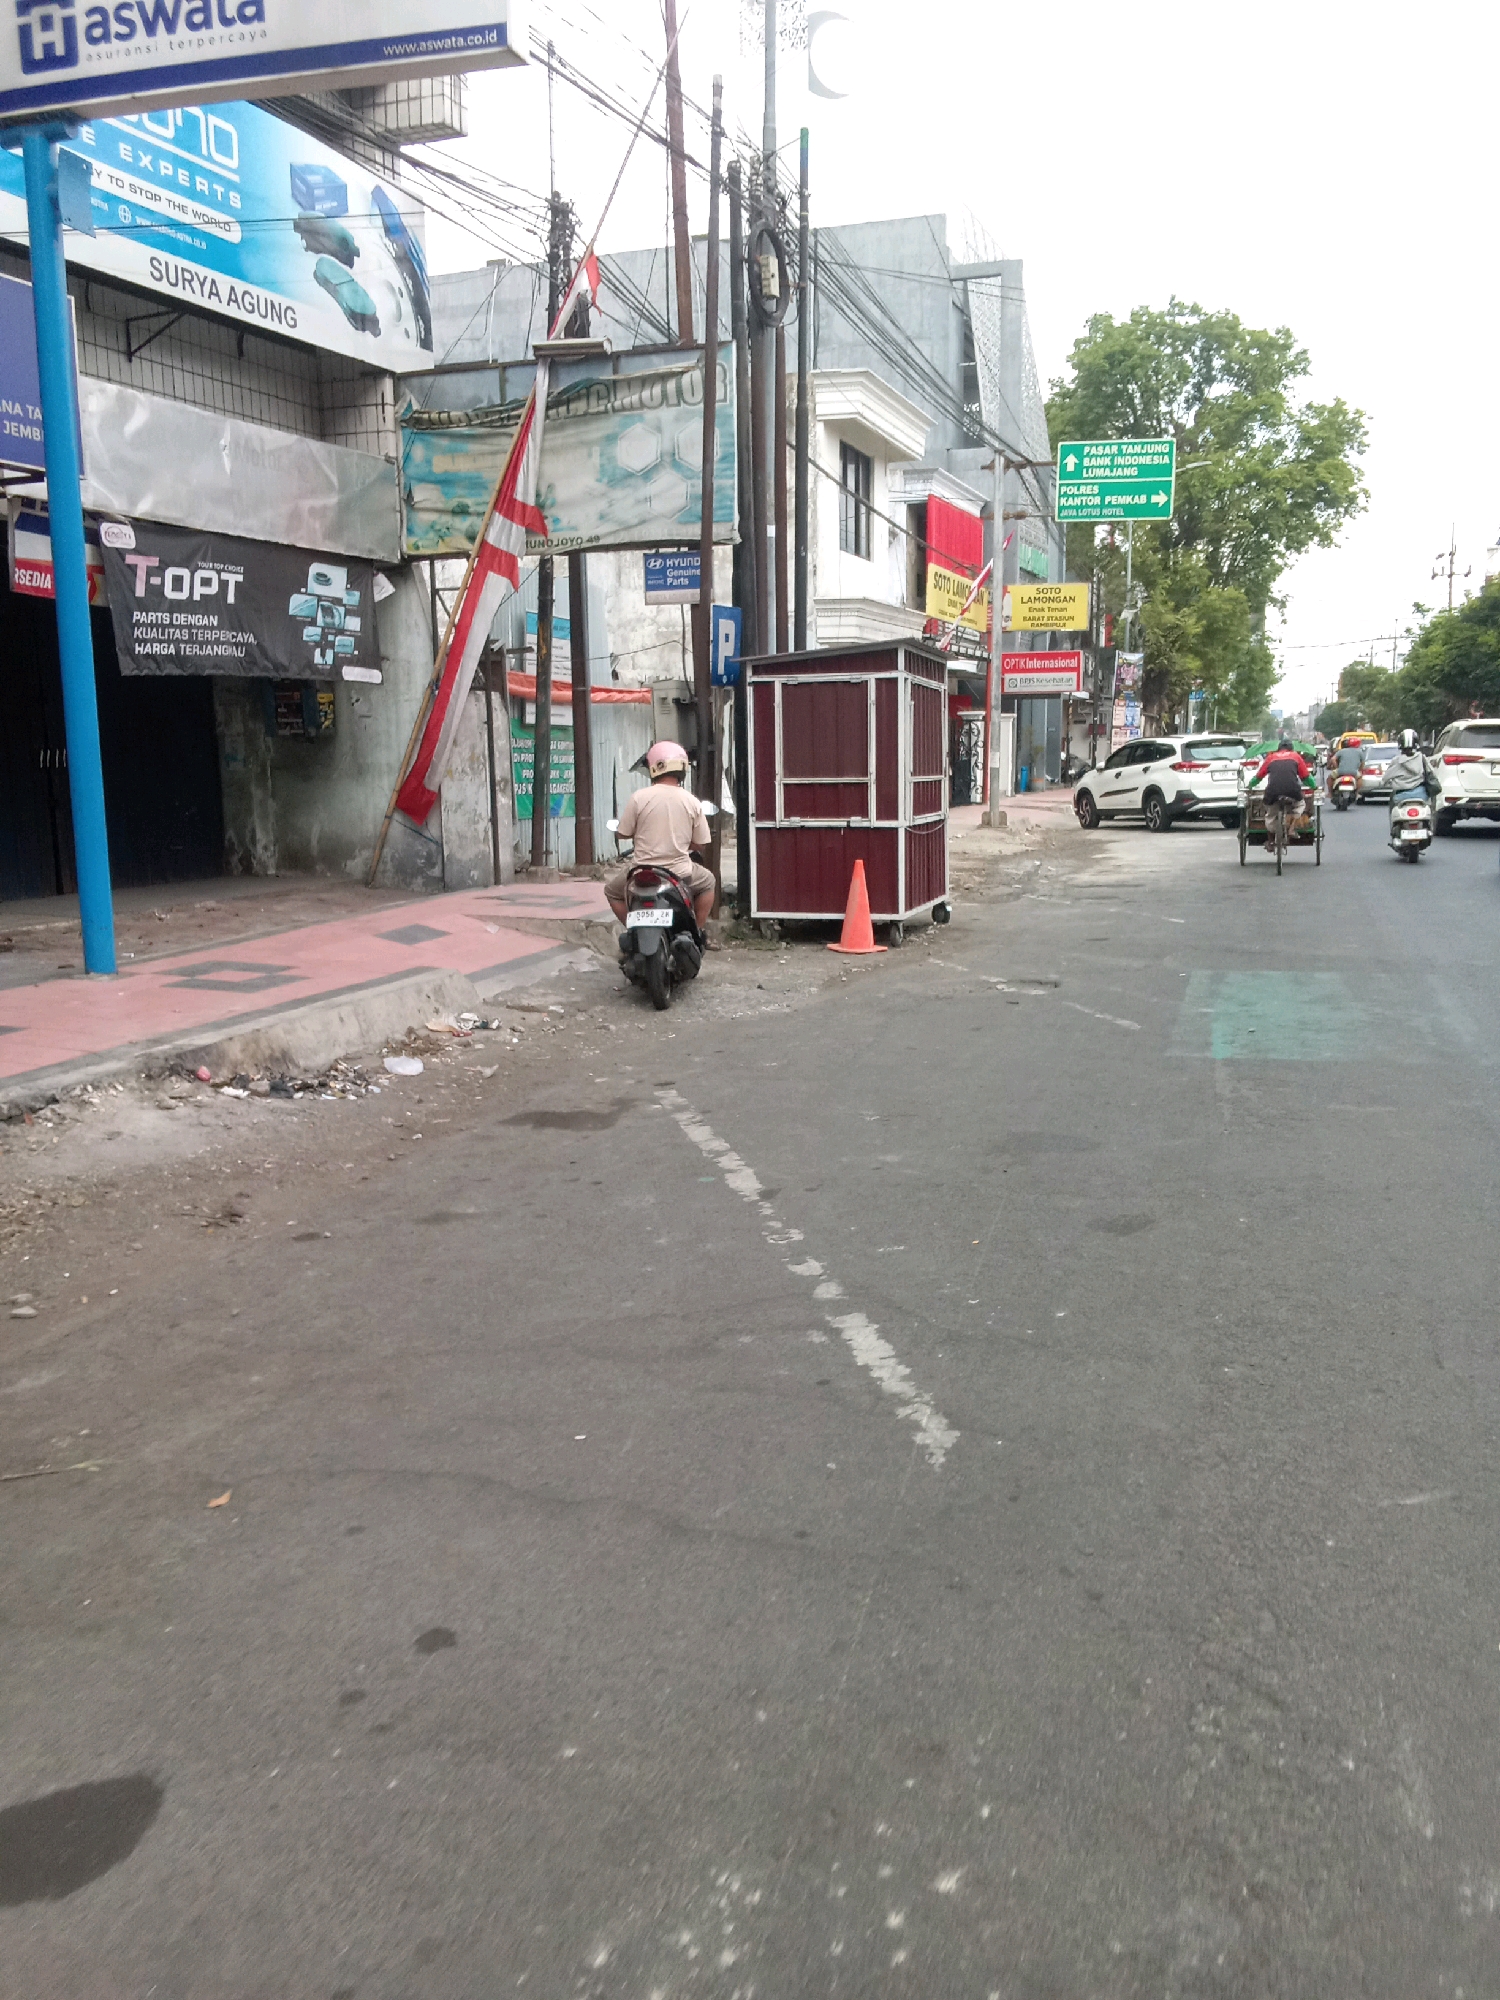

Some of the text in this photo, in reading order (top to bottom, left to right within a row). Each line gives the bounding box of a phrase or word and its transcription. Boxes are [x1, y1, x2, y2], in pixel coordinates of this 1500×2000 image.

[84, 0, 266, 46] aswata
[86, 29, 268, 62] asuransi terpercaya
[383, 29, 498, 56] www.aswata.co.id
[118, 141, 242, 210] EXPERTS
[107, 173, 126, 189] TO
[128, 183, 162, 203] STOP
[165, 198, 190, 215] THE
[191, 208, 232, 233] WORLD
[149, 255, 298, 330] SURYA AGUNG
[1083, 444, 1169, 456] PASAR TANJUNG
[1083, 455, 1170, 466] BANK INDONESIA
[1082, 467, 1138, 478] LUMAJANG
[1060, 485, 1099, 495] POLRES
[1060, 495, 1147, 506] KANTOR PEMKAB
[1078, 508, 1100, 516] LOTUS
[1102, 508, 1125, 516] HOTEL
[667, 557, 701, 568] HYUND
[125, 554, 244, 605] T-OPT
[667, 577, 689, 586] Parts
[933, 571, 951, 595] SOTO
[1036, 587, 1061, 595] SOTO
[1020, 596, 1075, 604] LAMONGAN
[132, 611, 218, 627] PARTS DENGAN
[133, 626, 189, 641] KUALITAS
[134, 642, 176, 656] HARGA
[718, 619, 735, 675] P
